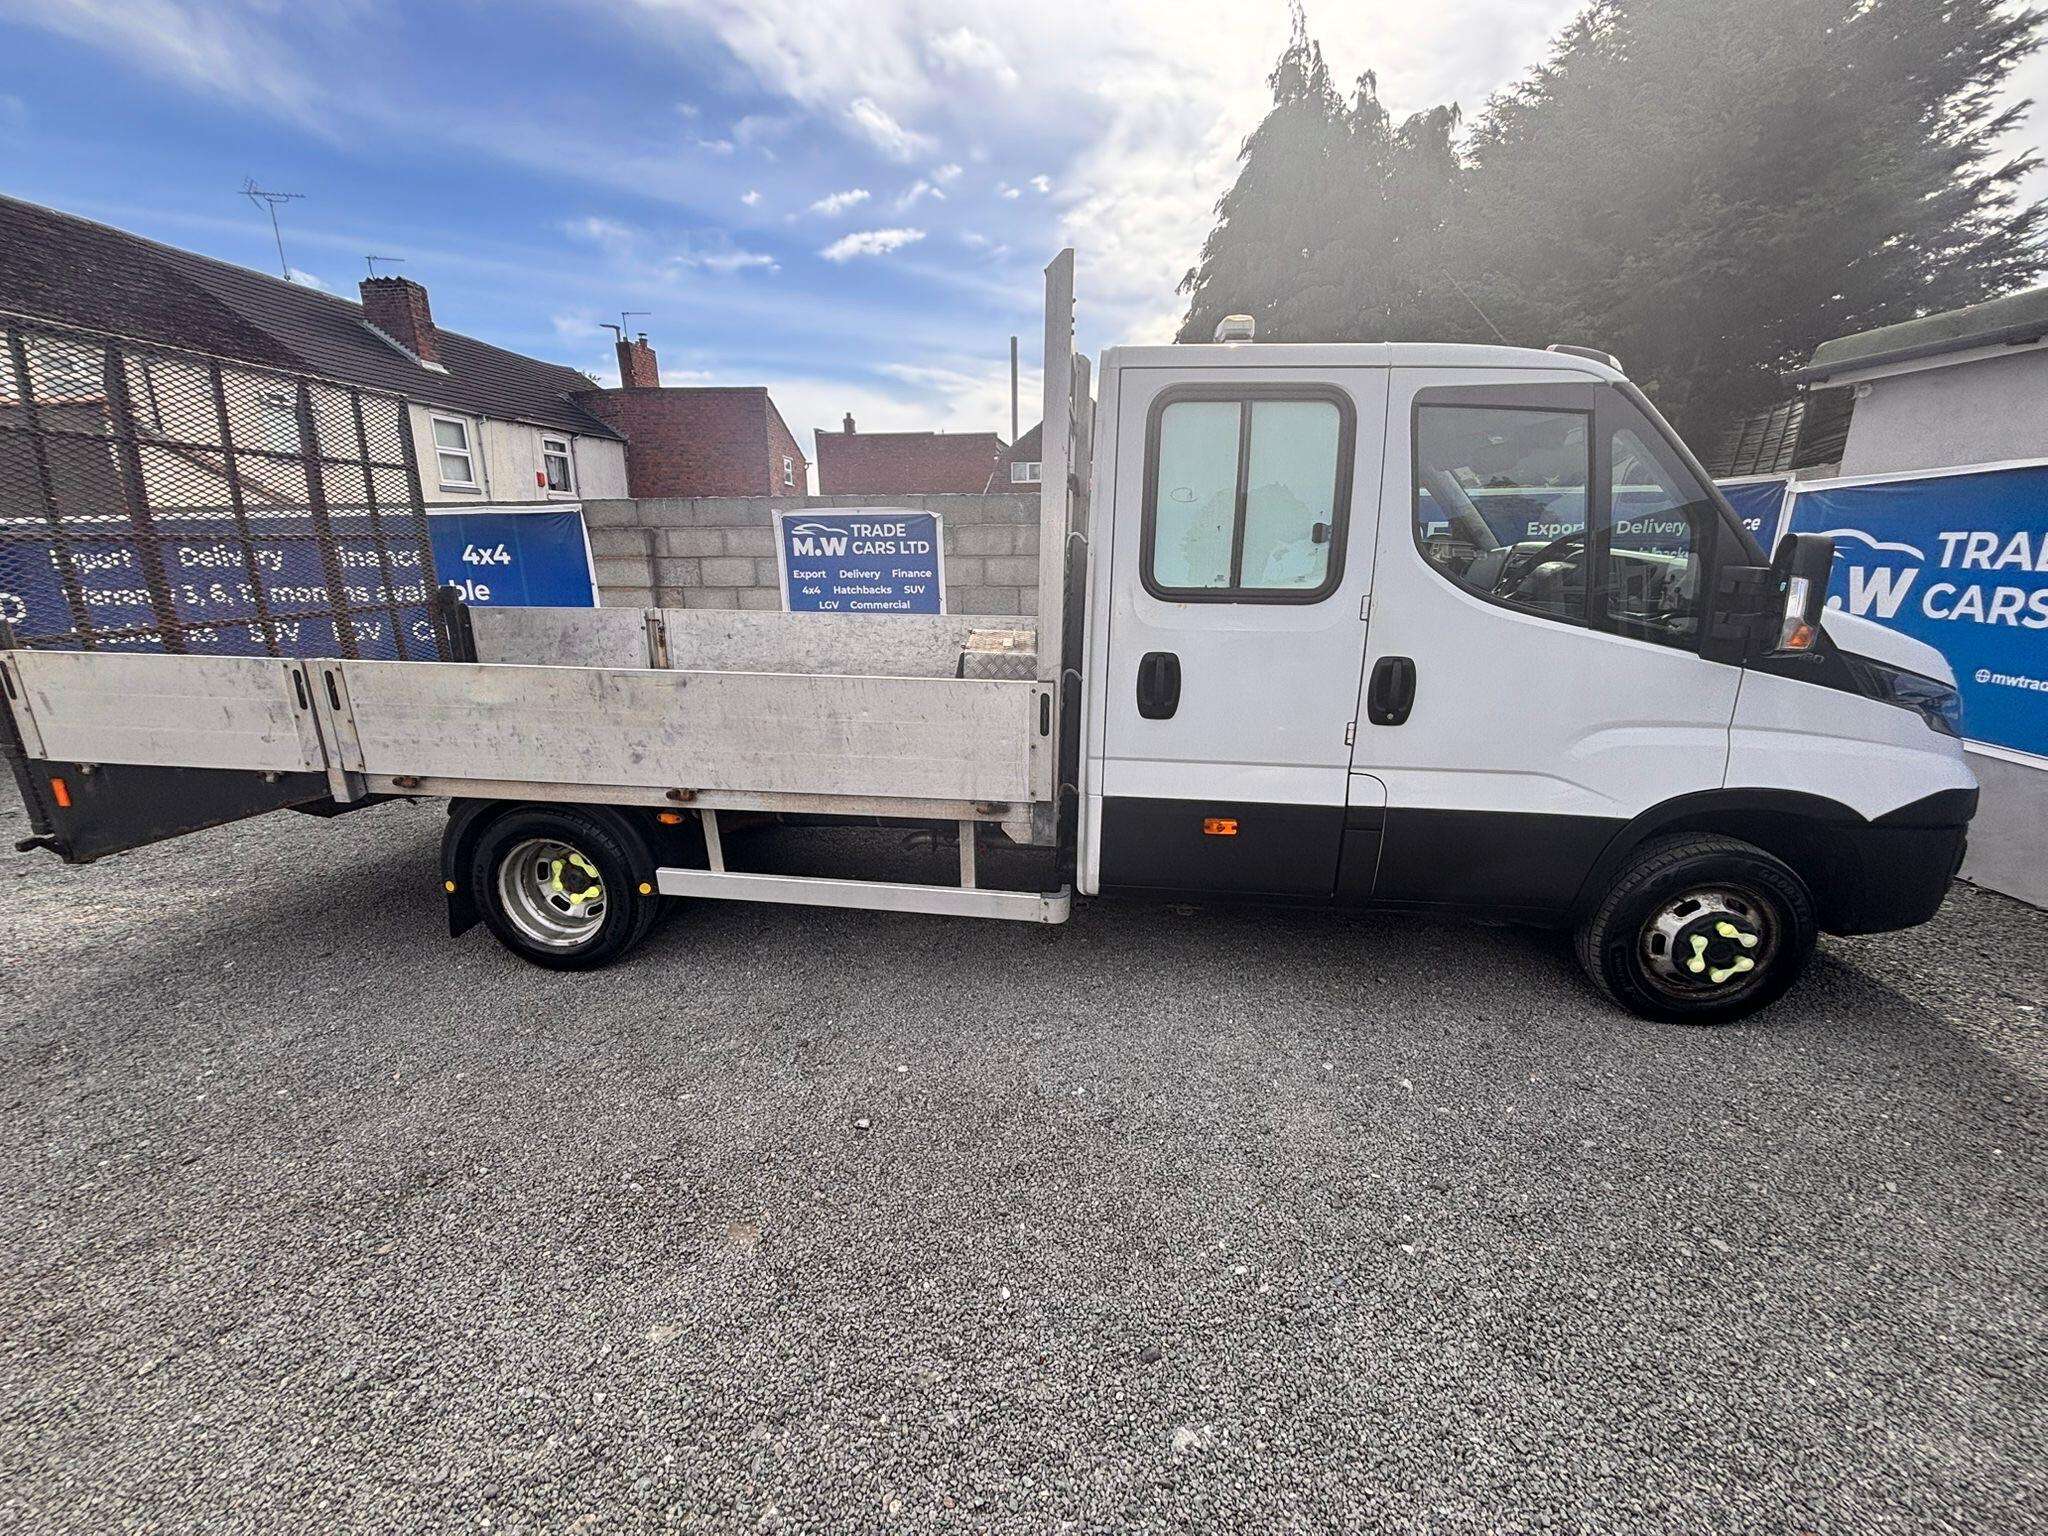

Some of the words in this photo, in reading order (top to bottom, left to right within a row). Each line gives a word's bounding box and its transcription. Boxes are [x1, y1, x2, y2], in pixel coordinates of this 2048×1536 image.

[850, 523, 906, 538] TRADE
[1616, 518, 1686, 537] Delivery
[792, 537, 848, 557] M.W
[852, 541, 896, 555] CARS
[900, 541, 930, 555] LTD
[178, 543, 283, 571] Delivry
[462, 543, 511, 566] 4x4
[793, 569, 827, 581] Export
[839, 569, 881, 581] Delivery
[892, 568, 933, 579] Finance
[802, 585, 821, 596] 4x4
[833, 585, 893, 595] Hatchbacks
[904, 585, 926, 595] SUV
[819, 600, 840, 610] LGV
[850, 600, 911, 610] Commercial
[1922, 582, 2048, 629] CARS
